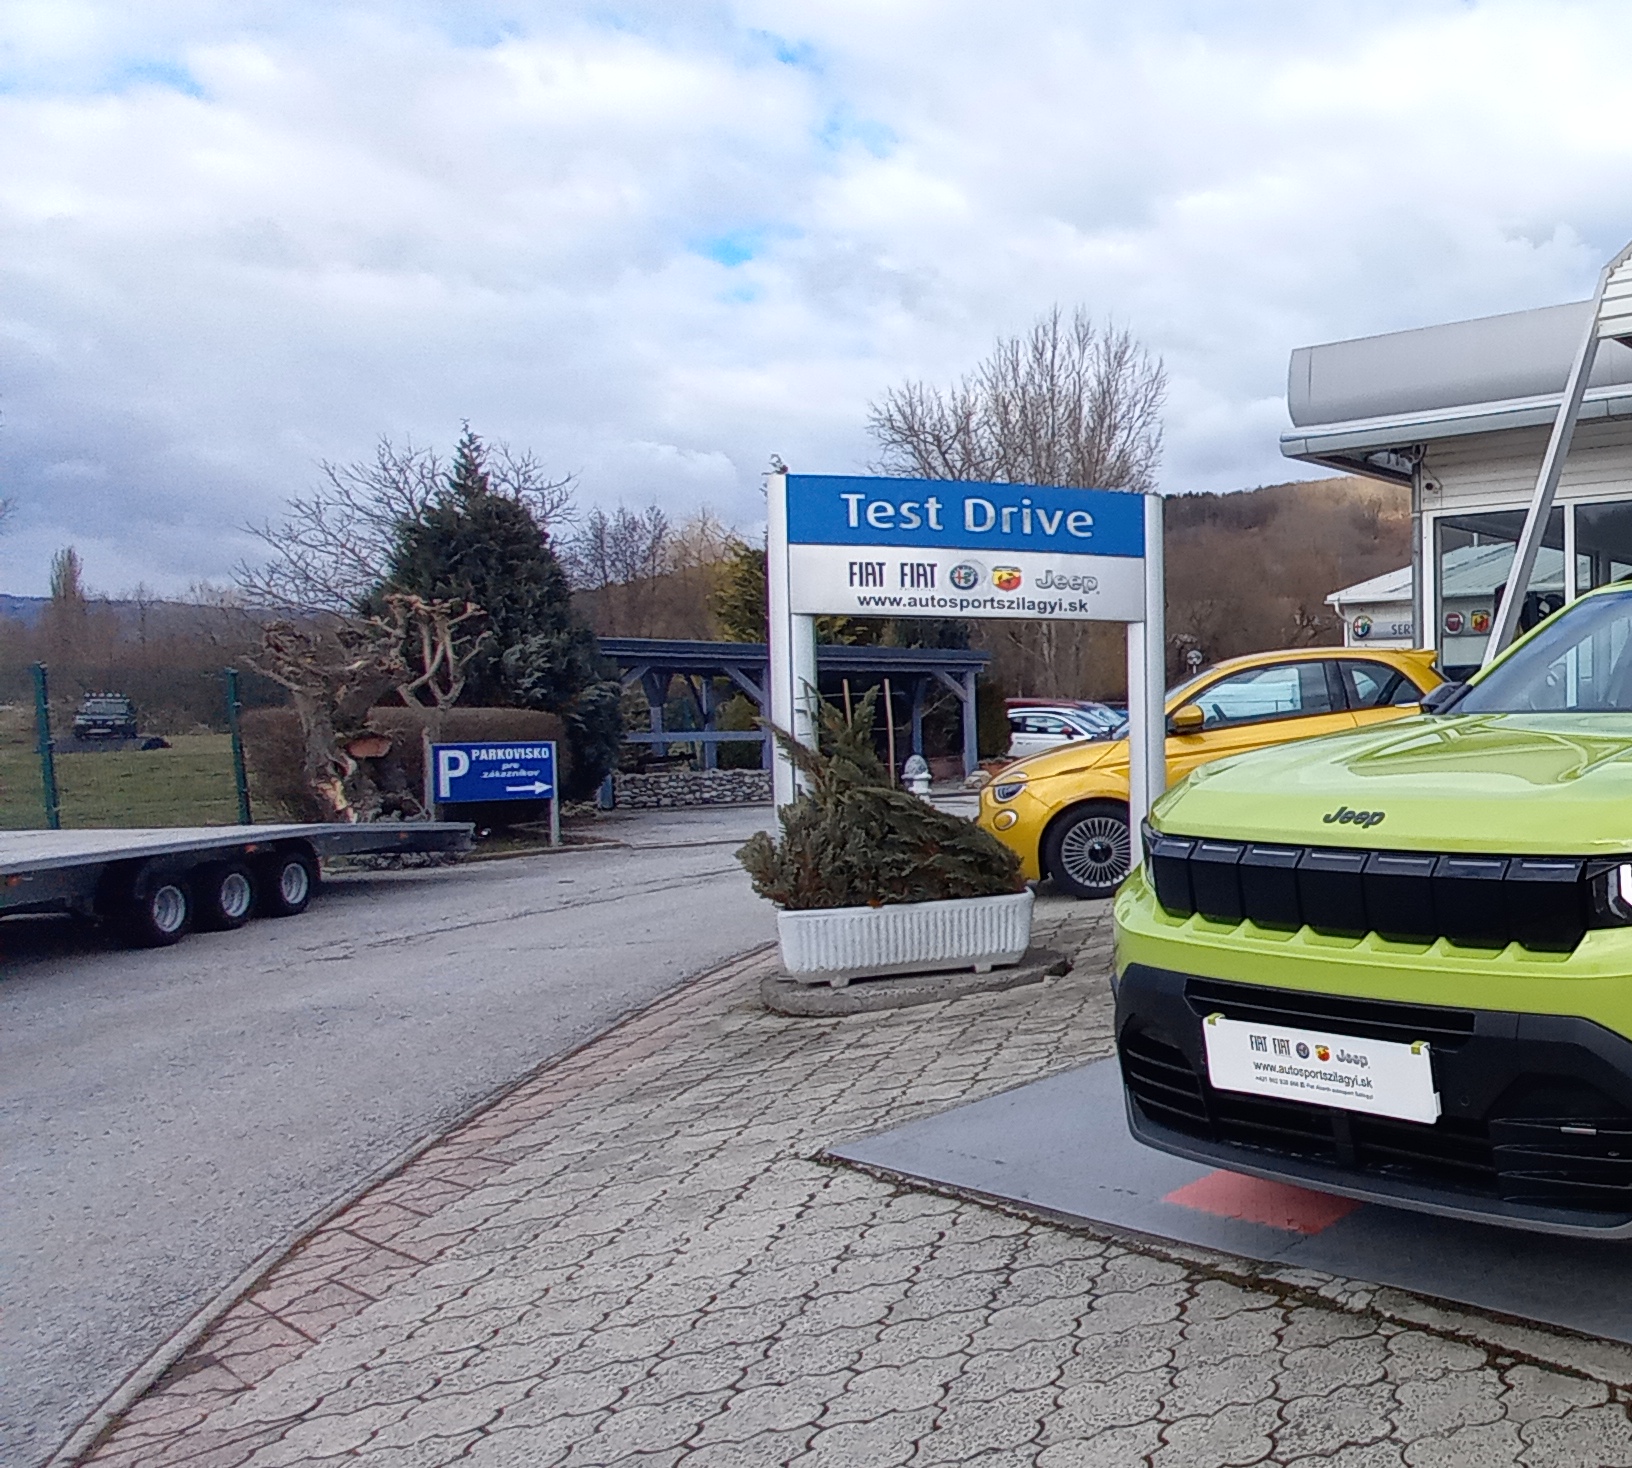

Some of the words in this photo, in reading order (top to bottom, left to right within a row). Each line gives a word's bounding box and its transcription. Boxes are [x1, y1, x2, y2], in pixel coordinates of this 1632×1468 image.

[840, 493, 944, 531] Test
[963, 498, 1095, 538] Drive
[849, 561, 887, 587] FIAT
[900, 562, 938, 589] FIAT
[1035, 569, 1099, 593] Jeep
[857, 593, 1089, 614] www.autosportszilagyi.sk
[438, 749, 470, 798] P
[471, 747, 550, 761] PARKOVISKO
[501, 762, 521, 771] pre
[1322, 806, 1386, 829] Jeep
[1249, 1034, 1268, 1052] FIAT
[1272, 1037, 1291, 1056] FIAT
[1336, 1049, 1369, 1068] Jeep
[1253, 1061, 1373, 1089] www.autosportszilagyi.sk
